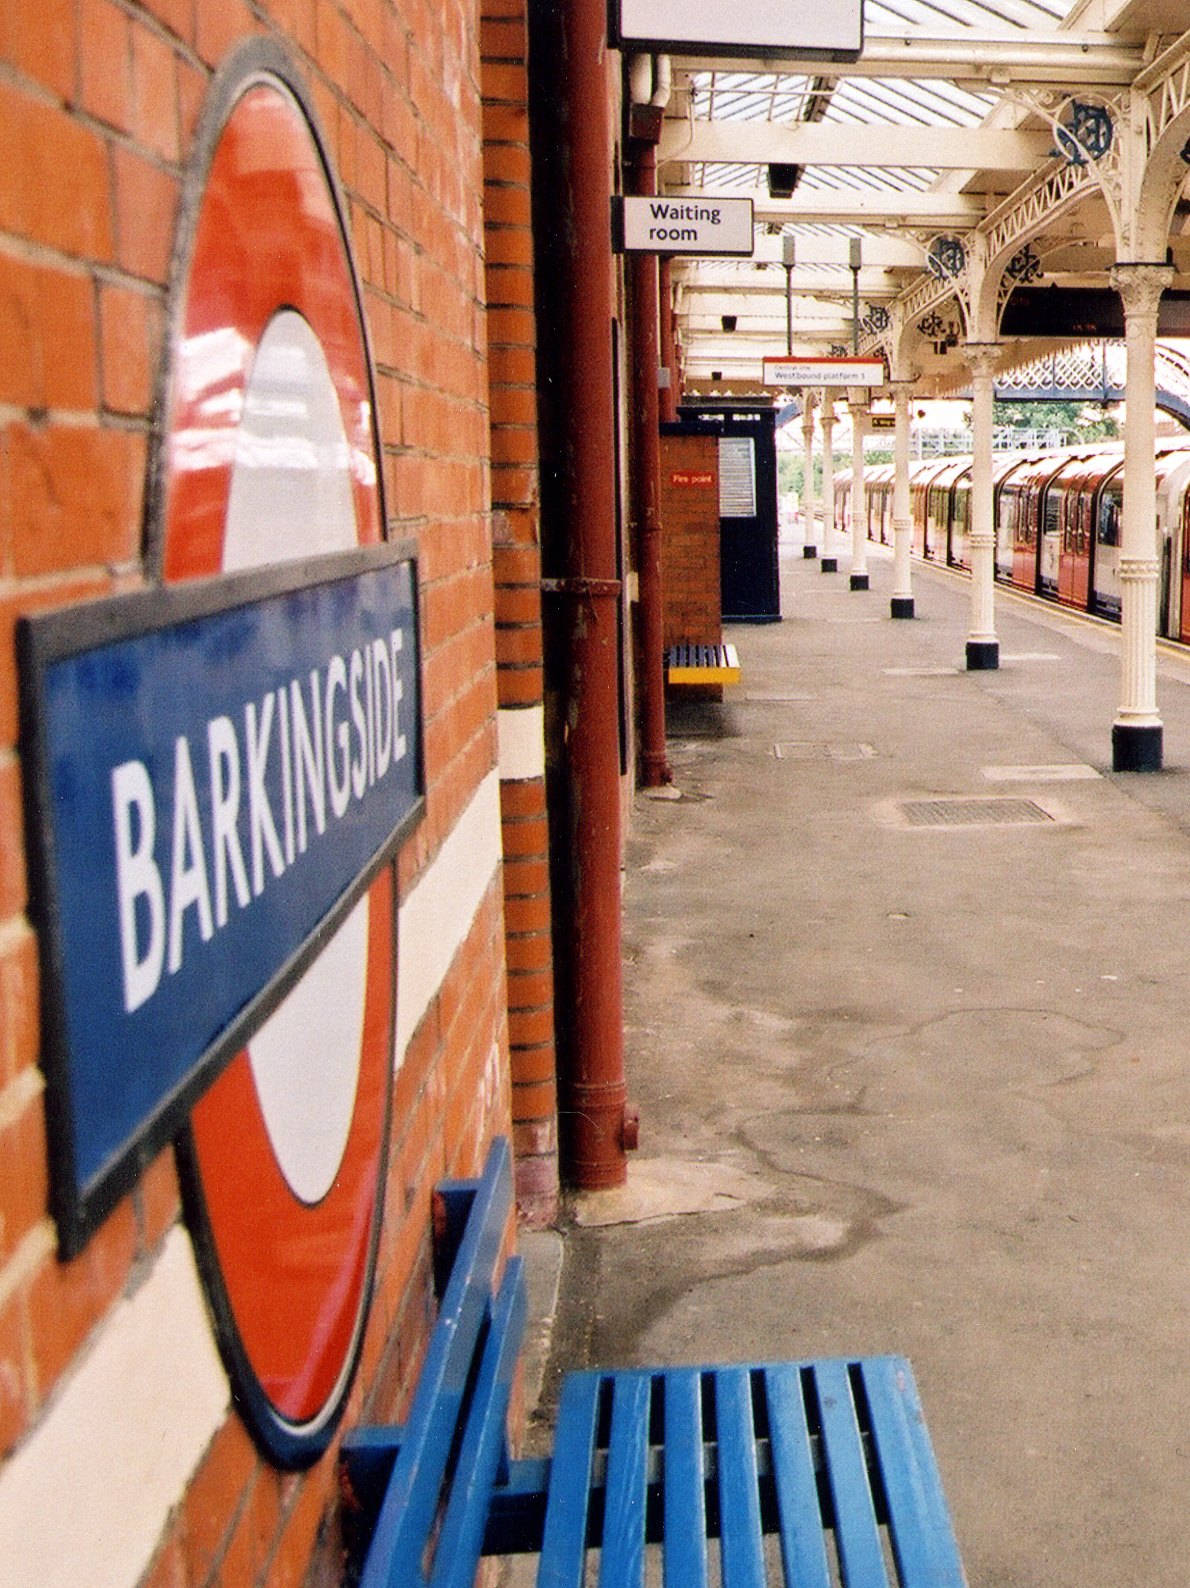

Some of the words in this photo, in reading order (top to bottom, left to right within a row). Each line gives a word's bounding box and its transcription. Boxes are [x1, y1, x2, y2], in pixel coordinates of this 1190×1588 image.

[649, 204, 721, 225] Waiting
[649, 228, 698, 241] room
[775, 372, 821, 380] Westbound
[823, 372, 858, 381] platform
[673, 474, 688, 483] Fire
[691, 474, 711, 484] point
[112, 628, 407, 1014] BARKINGSIDE
